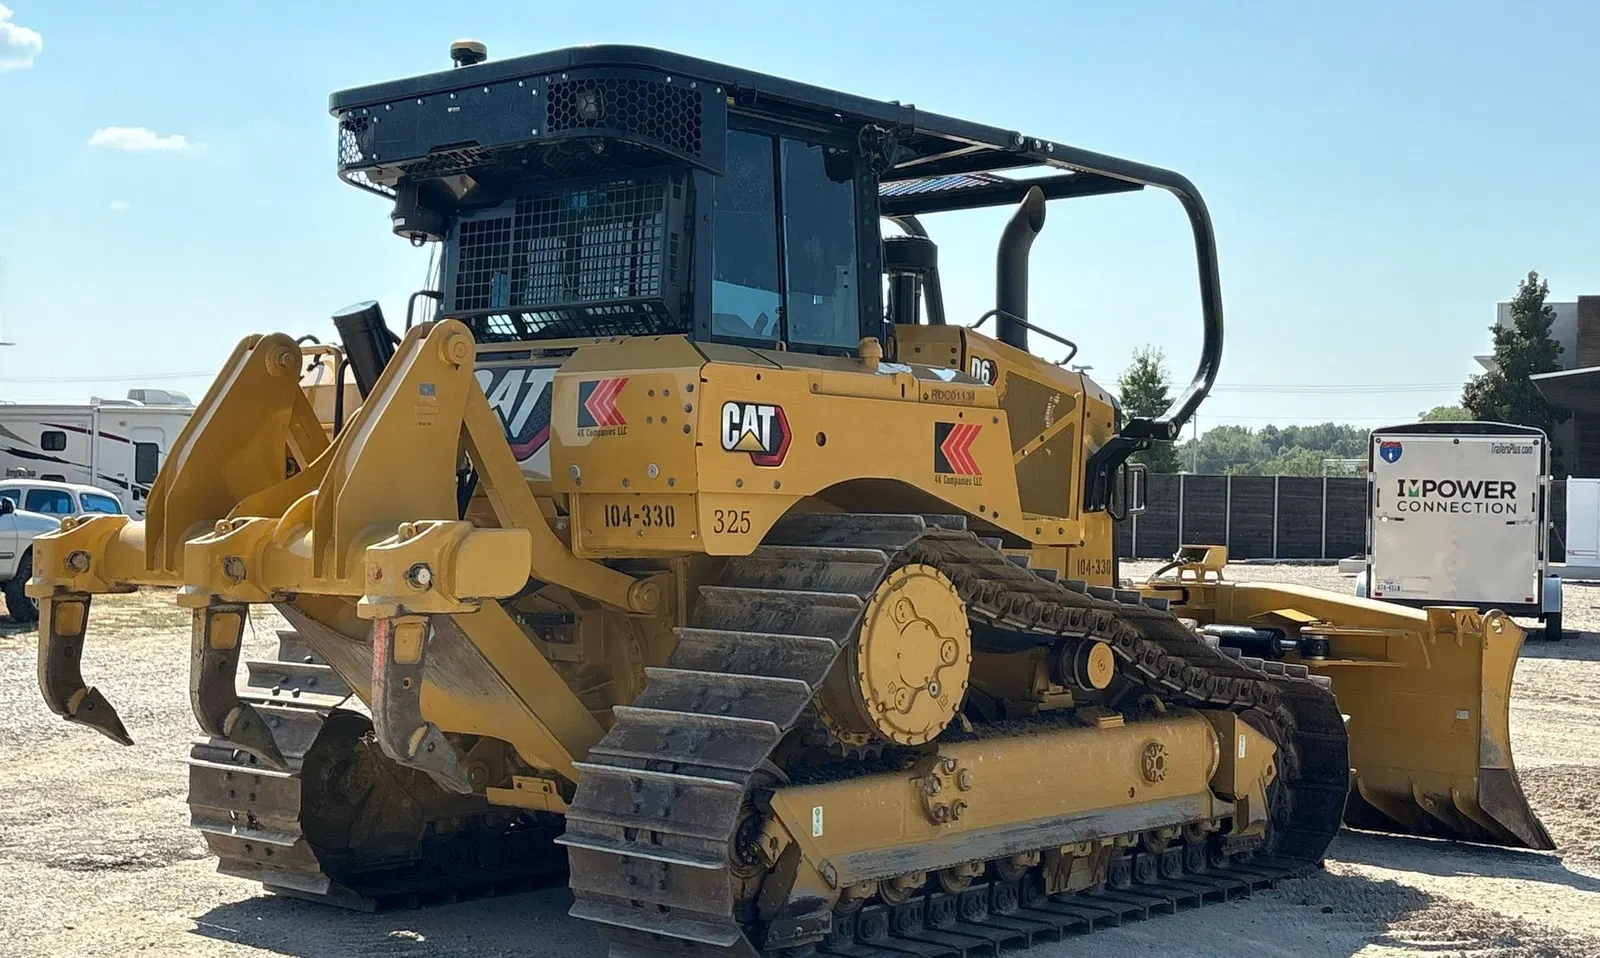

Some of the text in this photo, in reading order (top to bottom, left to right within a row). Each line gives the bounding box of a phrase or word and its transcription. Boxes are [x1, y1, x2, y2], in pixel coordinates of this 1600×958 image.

[970, 356, 991, 384] D6
[617, 426, 627, 436] LLC
[722, 402, 776, 452] CAT
[934, 475, 982, 487] 4K Companies LLC
[1397, 479, 1516, 499] IMPOWER
[604, 504, 675, 528] 104-330
[1397, 500, 1517, 514] CONNECTION
[713, 509, 751, 534] 325
[1077, 557, 1111, 576] 104-330
